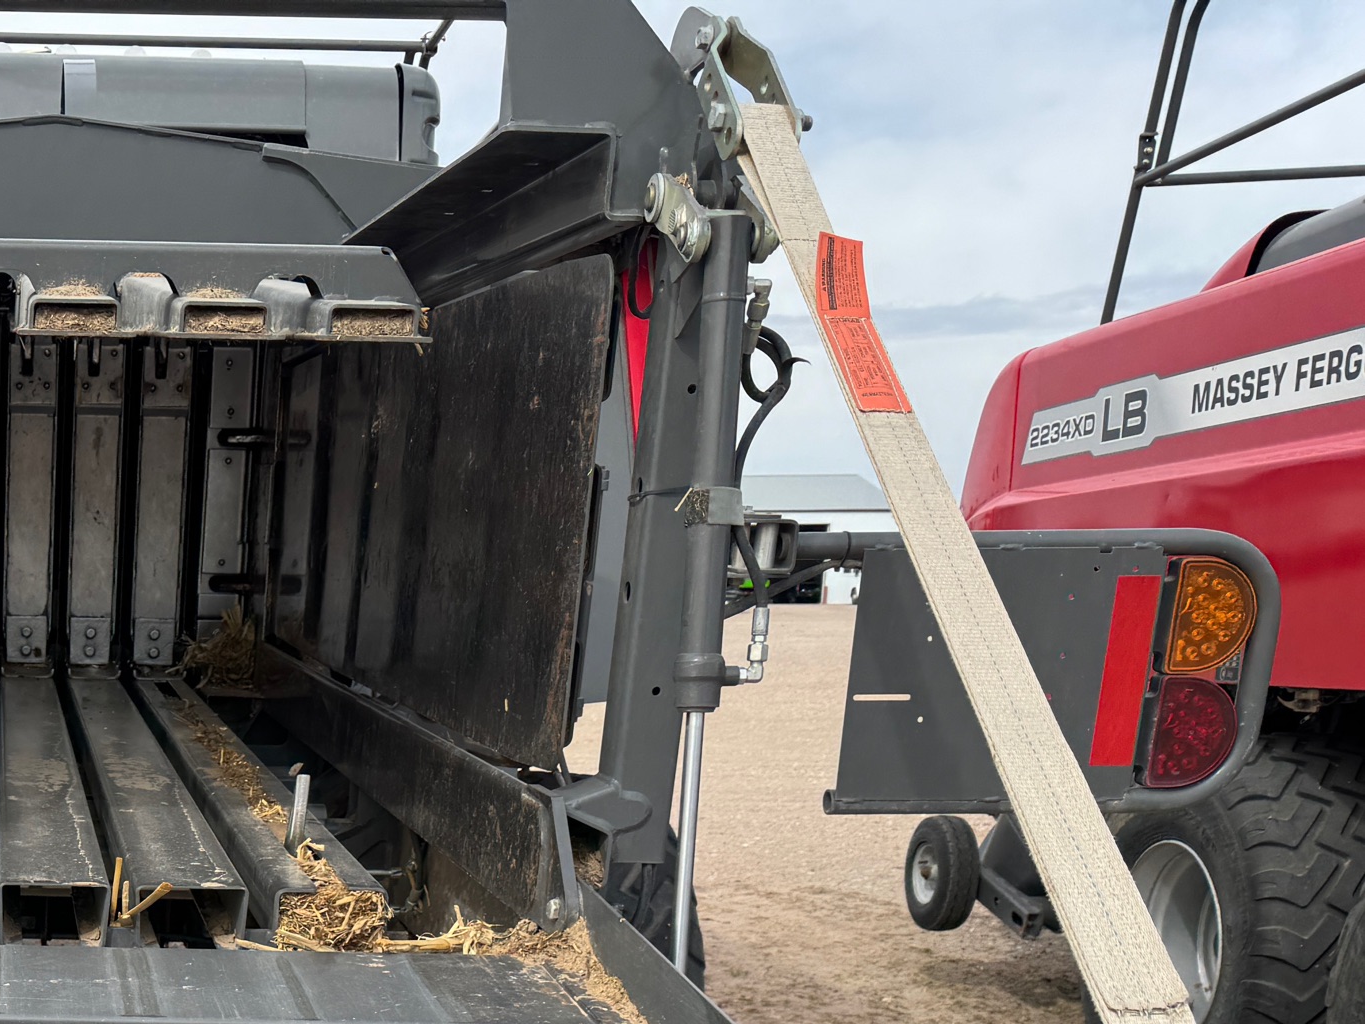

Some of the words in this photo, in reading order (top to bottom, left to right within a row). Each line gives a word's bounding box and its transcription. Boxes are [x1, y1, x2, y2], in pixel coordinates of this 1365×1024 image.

[1029, 413, 1096, 448] 2234XD
[1101, 388, 1148, 442] LB
[1191, 361, 1288, 414] MASSEY
